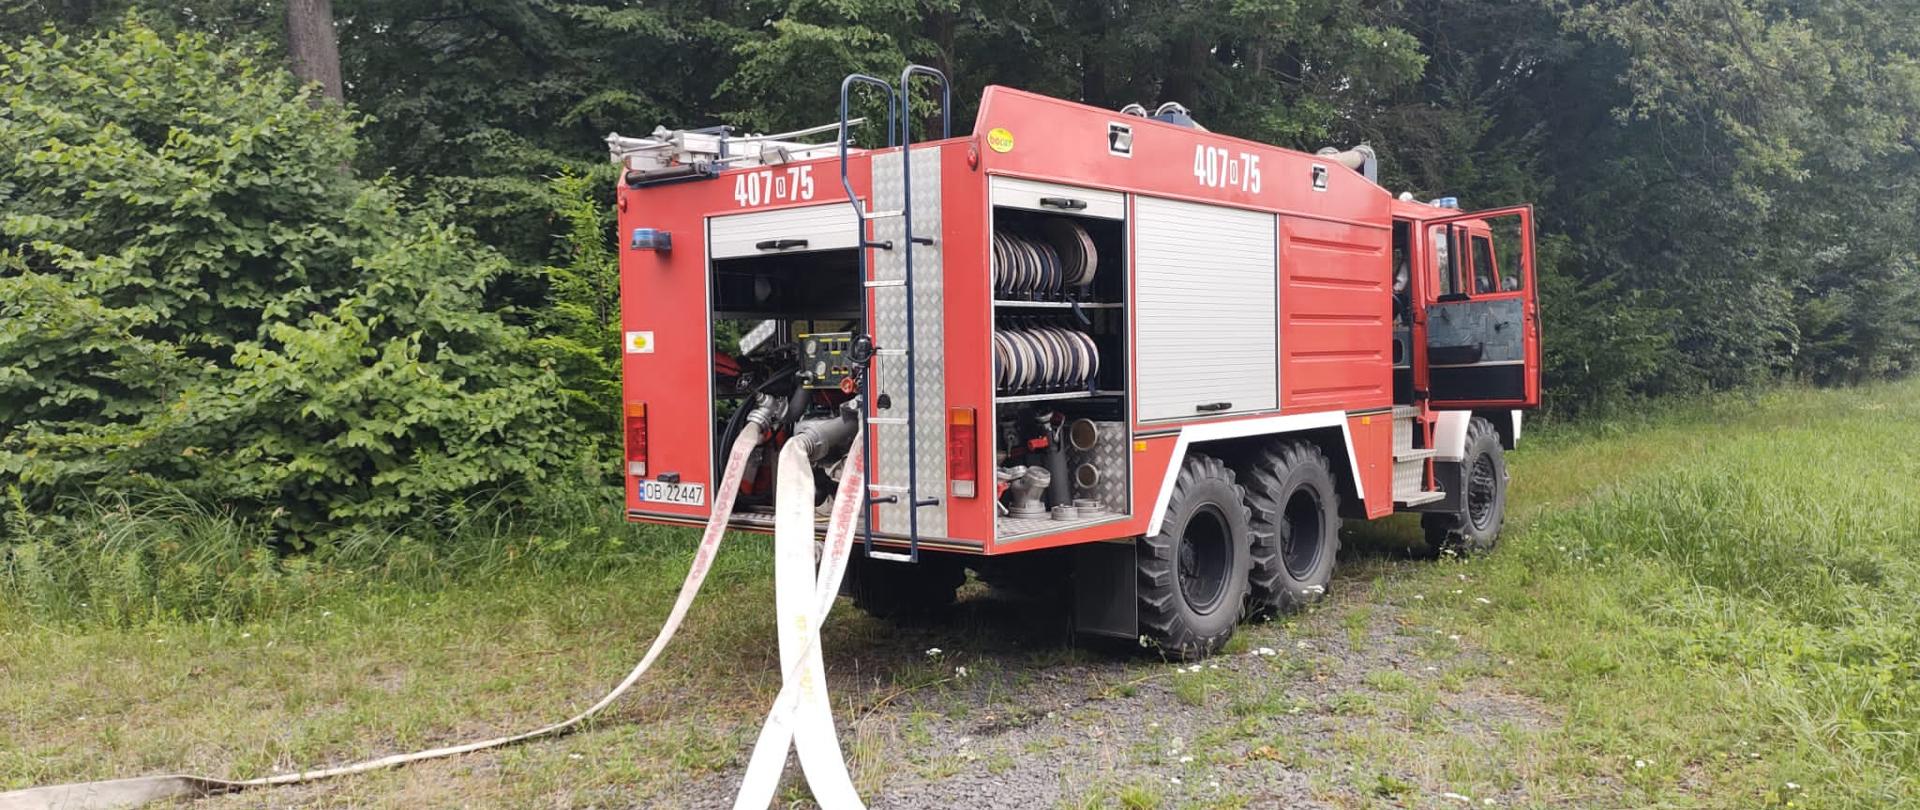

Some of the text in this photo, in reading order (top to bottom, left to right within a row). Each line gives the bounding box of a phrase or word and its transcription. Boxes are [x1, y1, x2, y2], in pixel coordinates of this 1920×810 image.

[735, 170, 773, 207] 407
[787, 165, 814, 200] 75
[1194, 144, 1228, 188] 407
[1240, 152, 1261, 194] 75
[646, 483, 661, 499] OB
[667, 484, 702, 503] 22447
